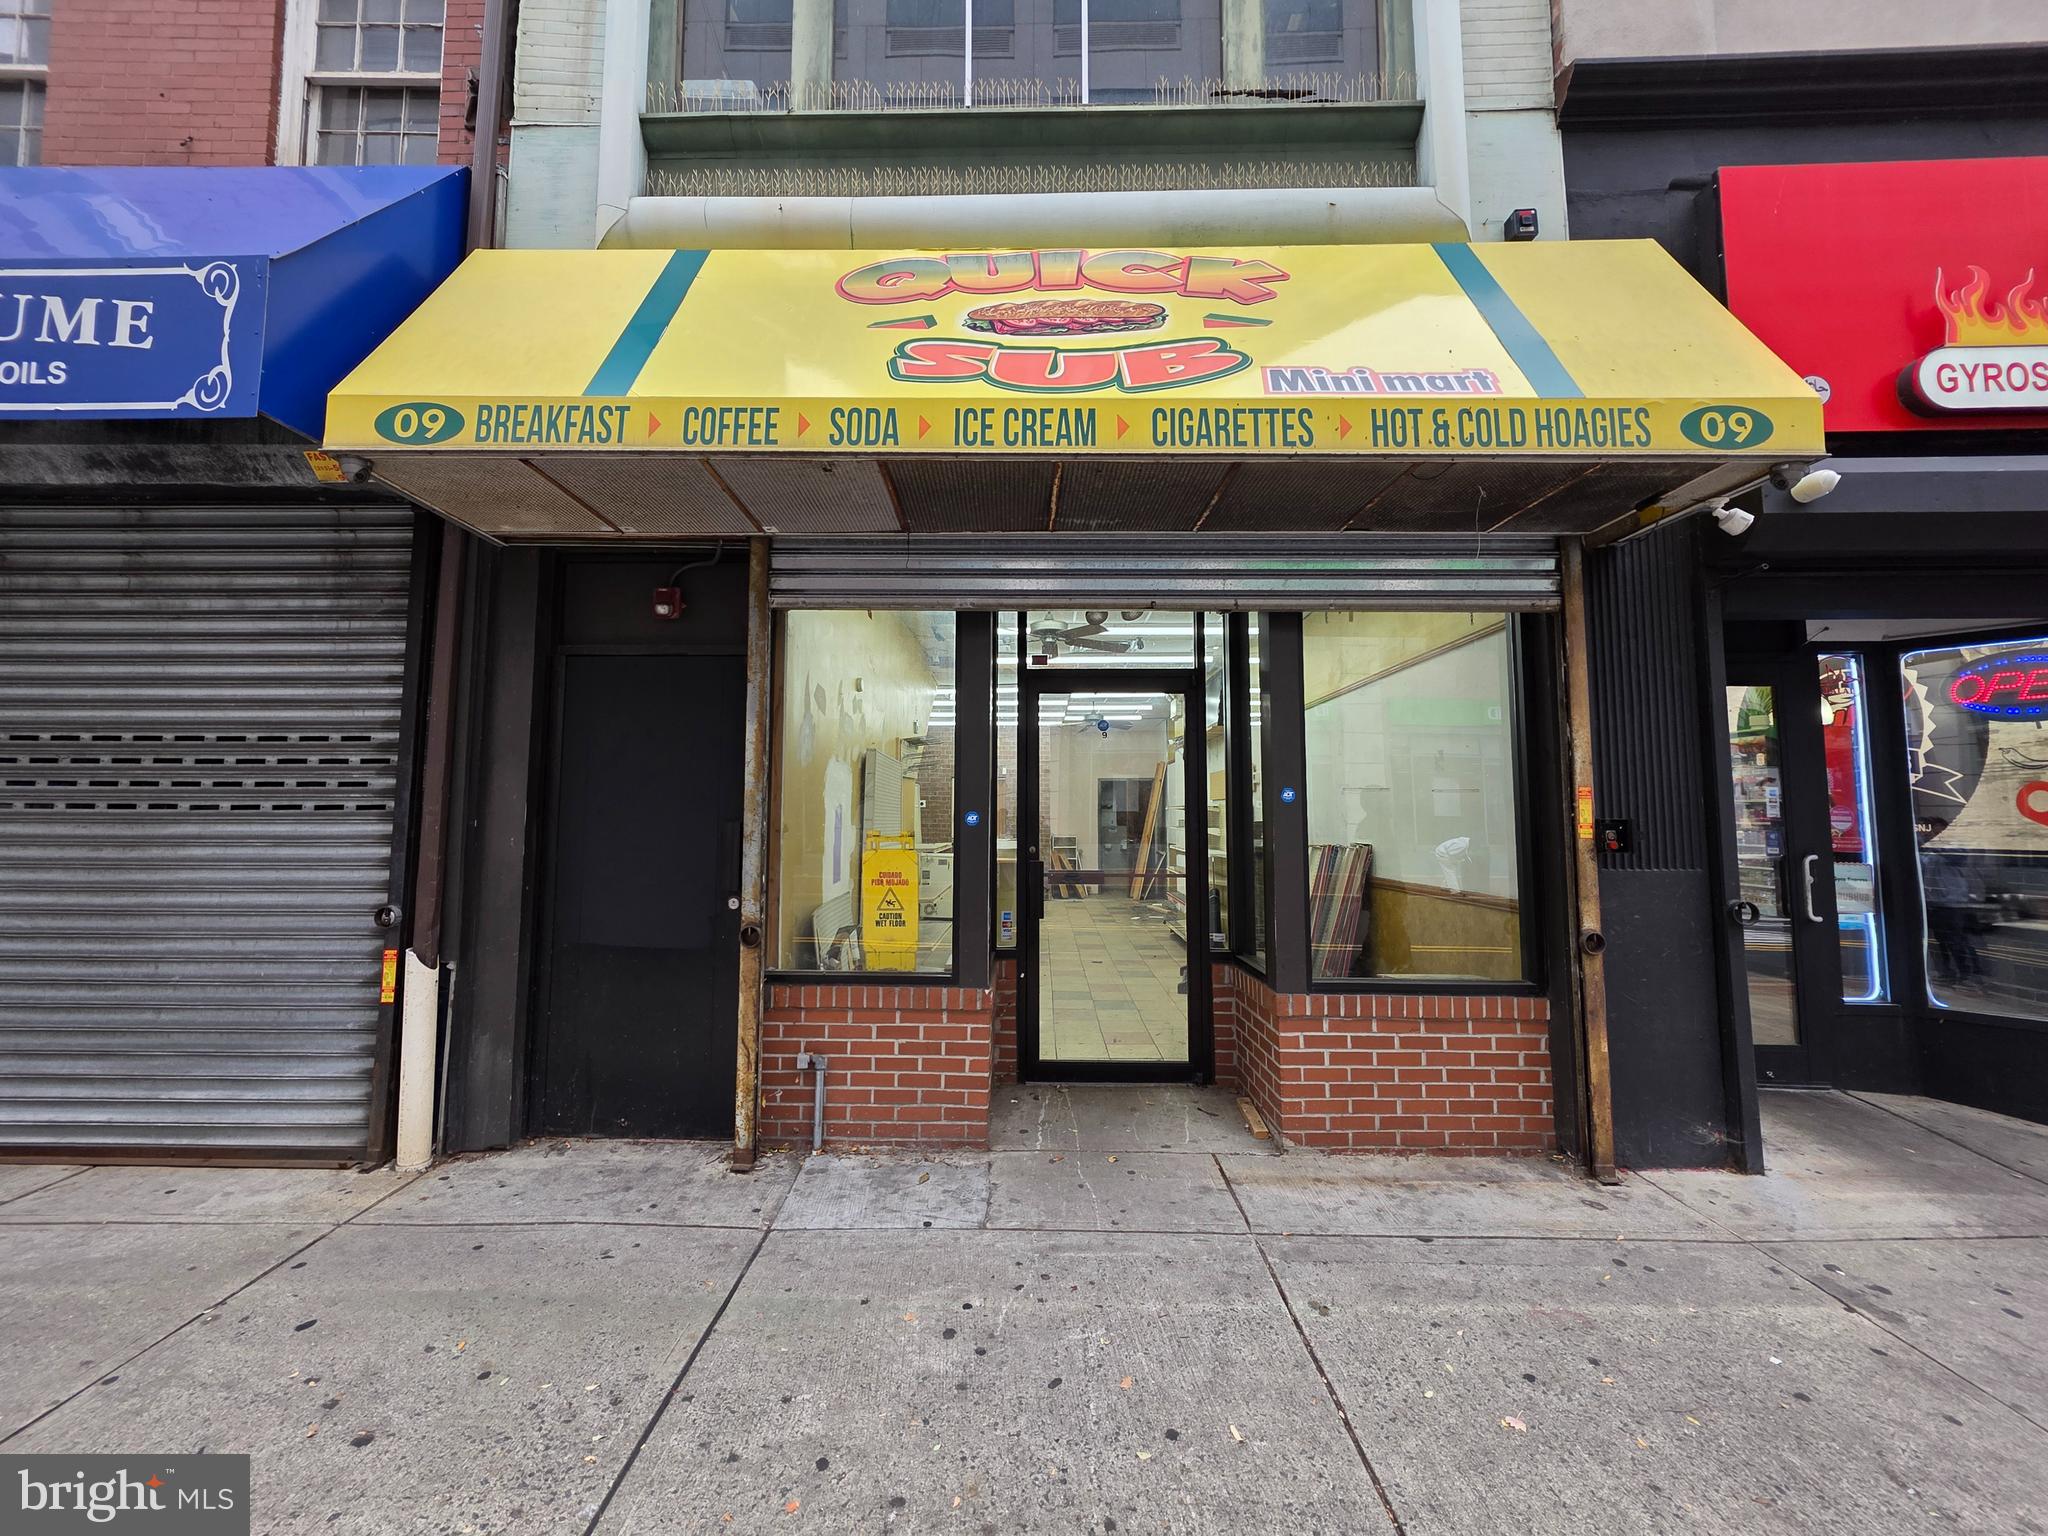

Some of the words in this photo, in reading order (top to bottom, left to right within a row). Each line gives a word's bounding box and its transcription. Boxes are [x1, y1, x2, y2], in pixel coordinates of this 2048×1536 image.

[835, 250, 1290, 304] QUICK
[0, 361, 67, 385] OILS
[888, 336, 1254, 394] SUB
[1266, 366, 1384, 393] Mini
[1384, 369, 1501, 393] mart
[1935, 361, 2048, 394] GYROS
[393, 408, 446, 439] 09
[474, 405, 631, 443] BREAKFAST
[682, 406, 779, 446] COFFEE
[829, 407, 900, 447] SODA
[954, 407, 996, 447] ICE
[1003, 407, 1097, 447] CREAM
[1151, 407, 1315, 448] CIGARETTES
[1371, 407, 1424, 448] HOT
[1432, 409, 1451, 448] &
[1457, 407, 1528, 448] COLD
[1535, 407, 1652, 448] HOAGIES
[1699, 411, 1754, 443] 09
[875, 920, 888, 928] WET
[889, 920, 906, 928] FLOOR
[879, 912, 902, 920] CAUTION
